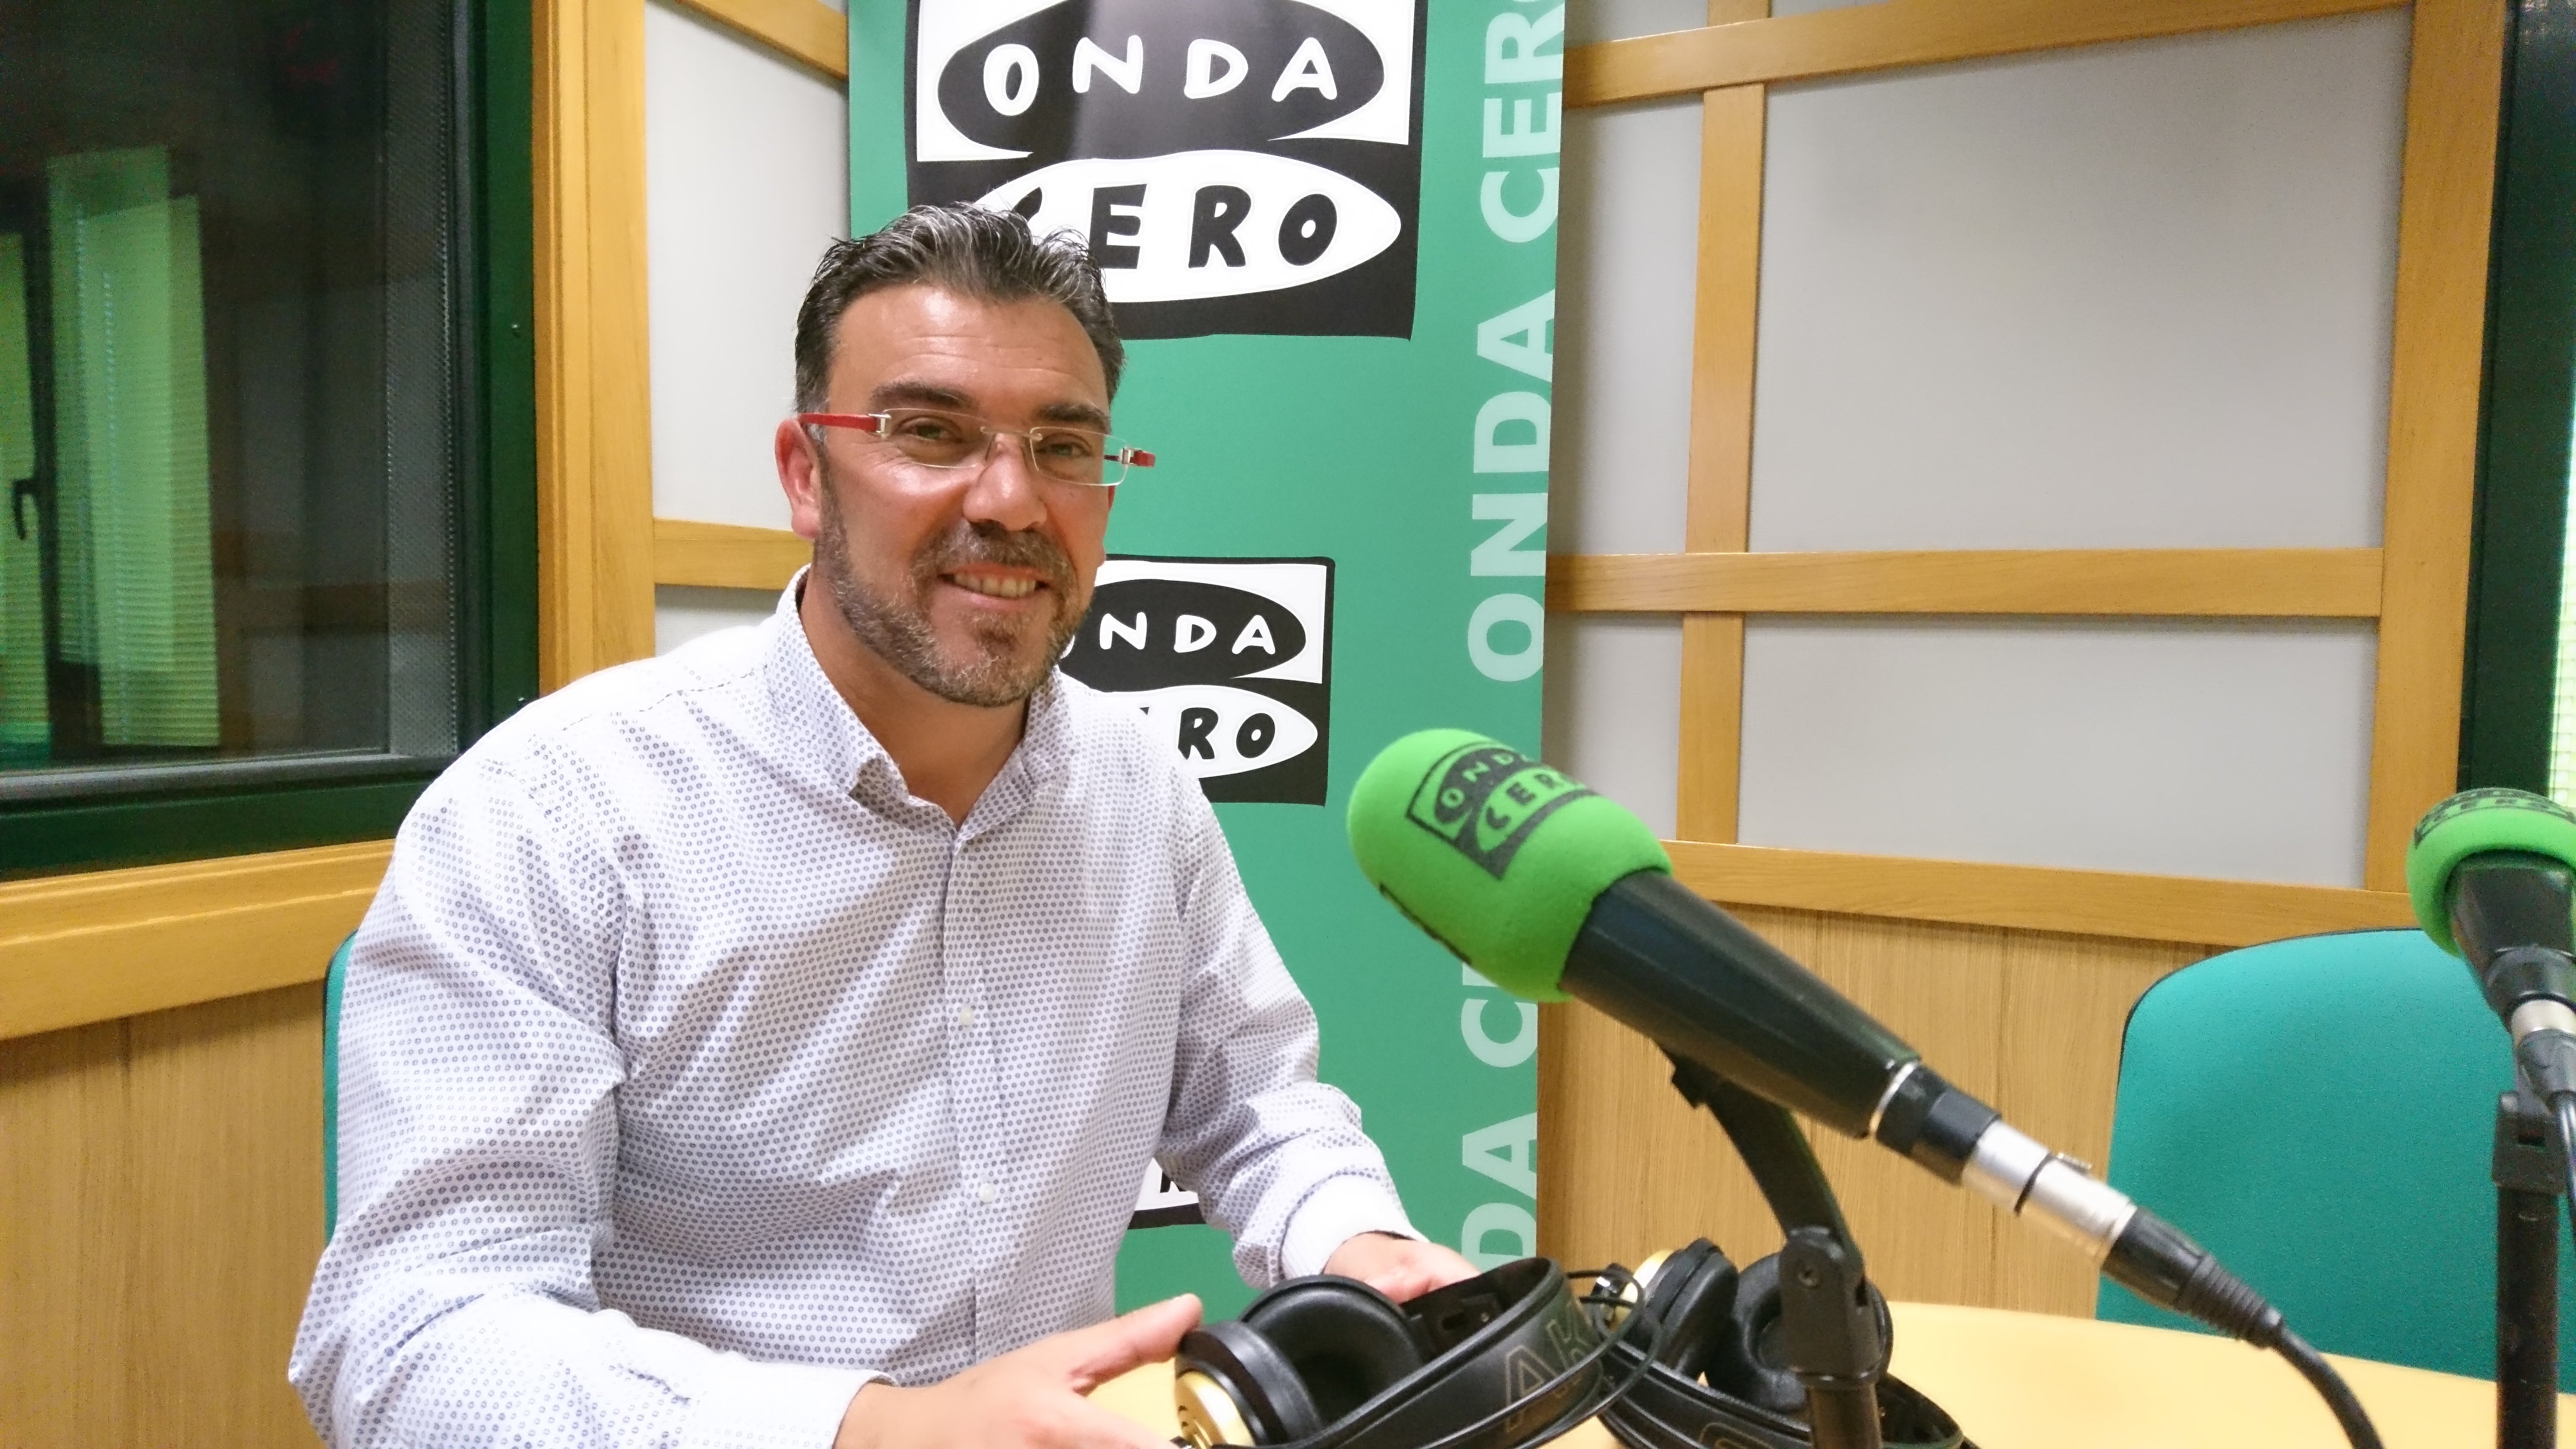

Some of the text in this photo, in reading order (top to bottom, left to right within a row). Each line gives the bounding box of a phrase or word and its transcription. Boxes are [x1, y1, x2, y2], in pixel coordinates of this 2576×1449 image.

[983, 35, 1338, 116] ONDA
[1012, 184, 1338, 269] ERO
[1468, 0, 1565, 682] ONDA CER
[1060, 612, 1275, 659] NDA
[1441, 753, 1532, 809] OND
[1487, 774, 1558, 830] CER
[1461, 1112, 1537, 1275] DA
